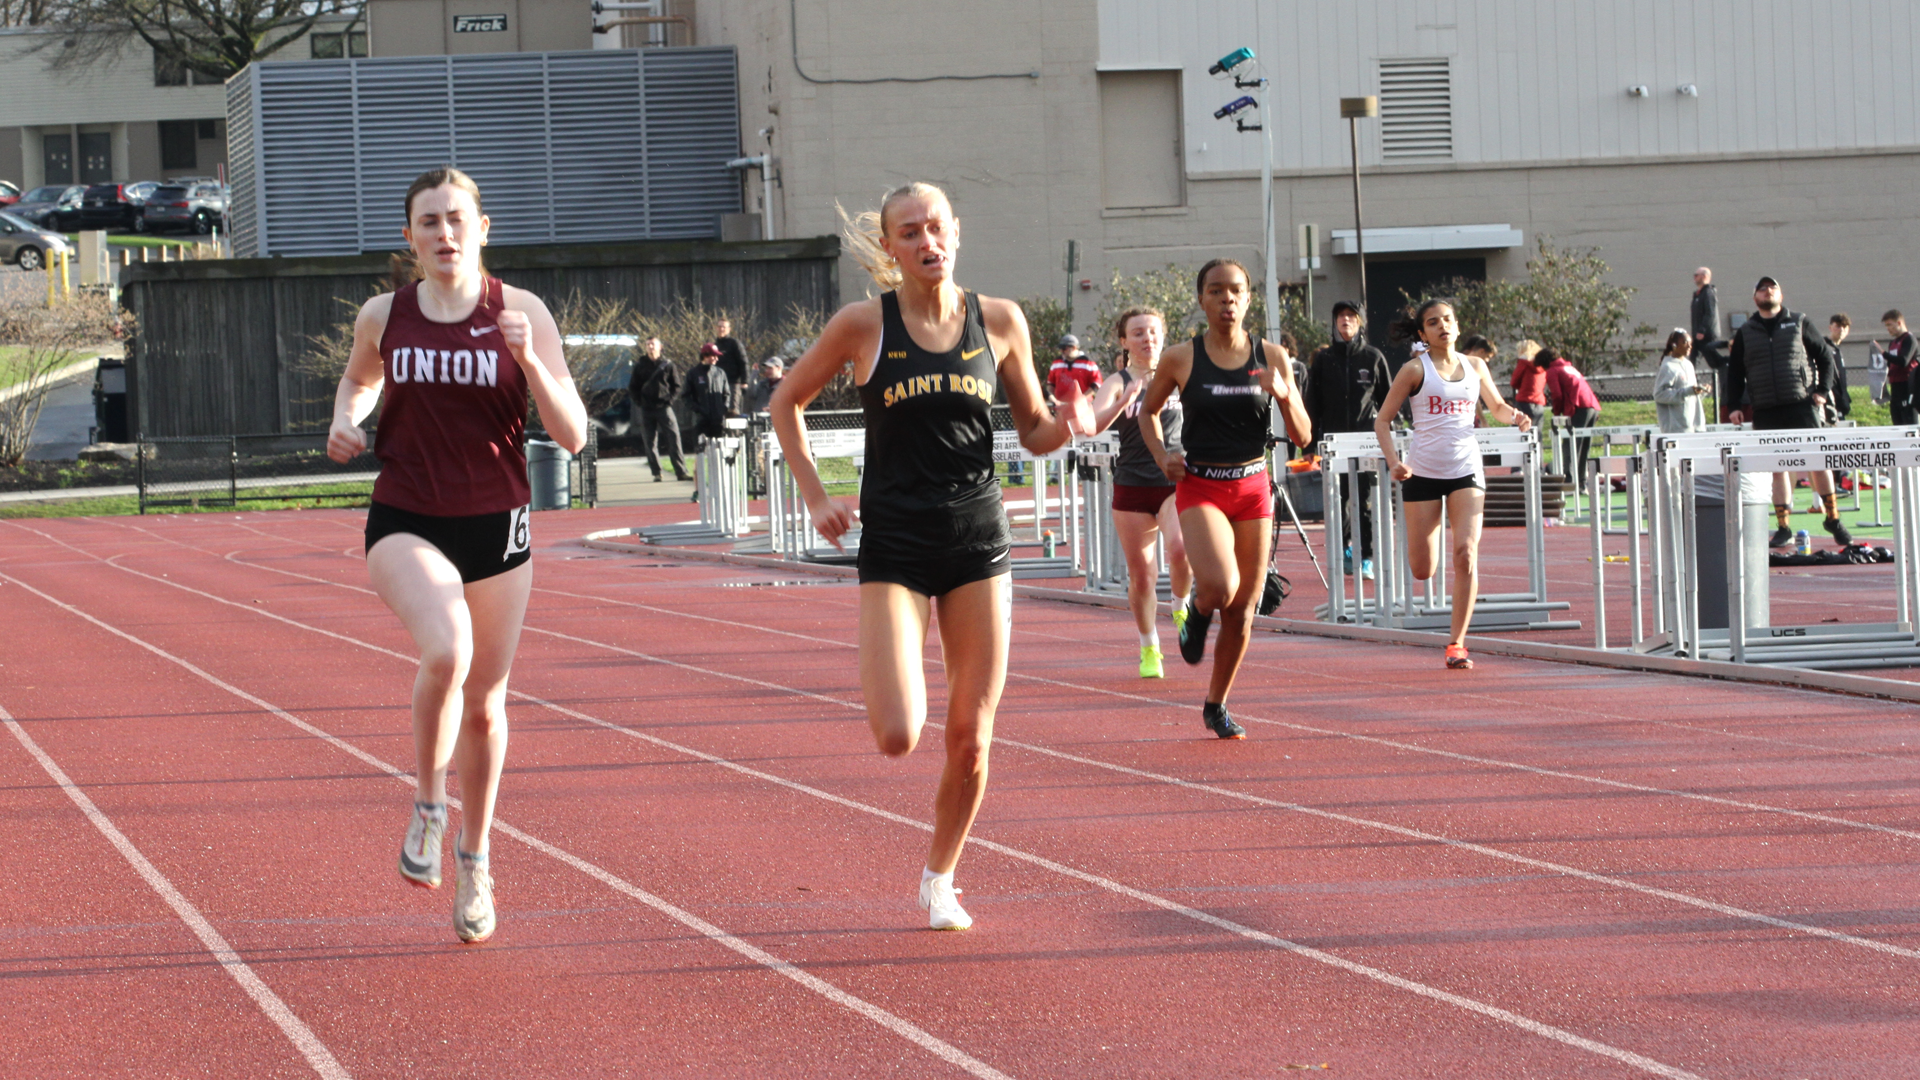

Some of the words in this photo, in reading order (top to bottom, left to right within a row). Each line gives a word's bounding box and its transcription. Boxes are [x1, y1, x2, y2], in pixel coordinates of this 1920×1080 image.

[455, 19, 504, 31] Frick
[392, 346, 498, 388] UNION
[883, 373, 943, 408] SAINT
[1786, 458, 1807, 467] UCS
[1825, 452, 1897, 469] RENSSELAER
[1205, 467, 1243, 478] NIKE
[514, 505, 527, 550] 6
[1771, 628, 1806, 637] UCS
